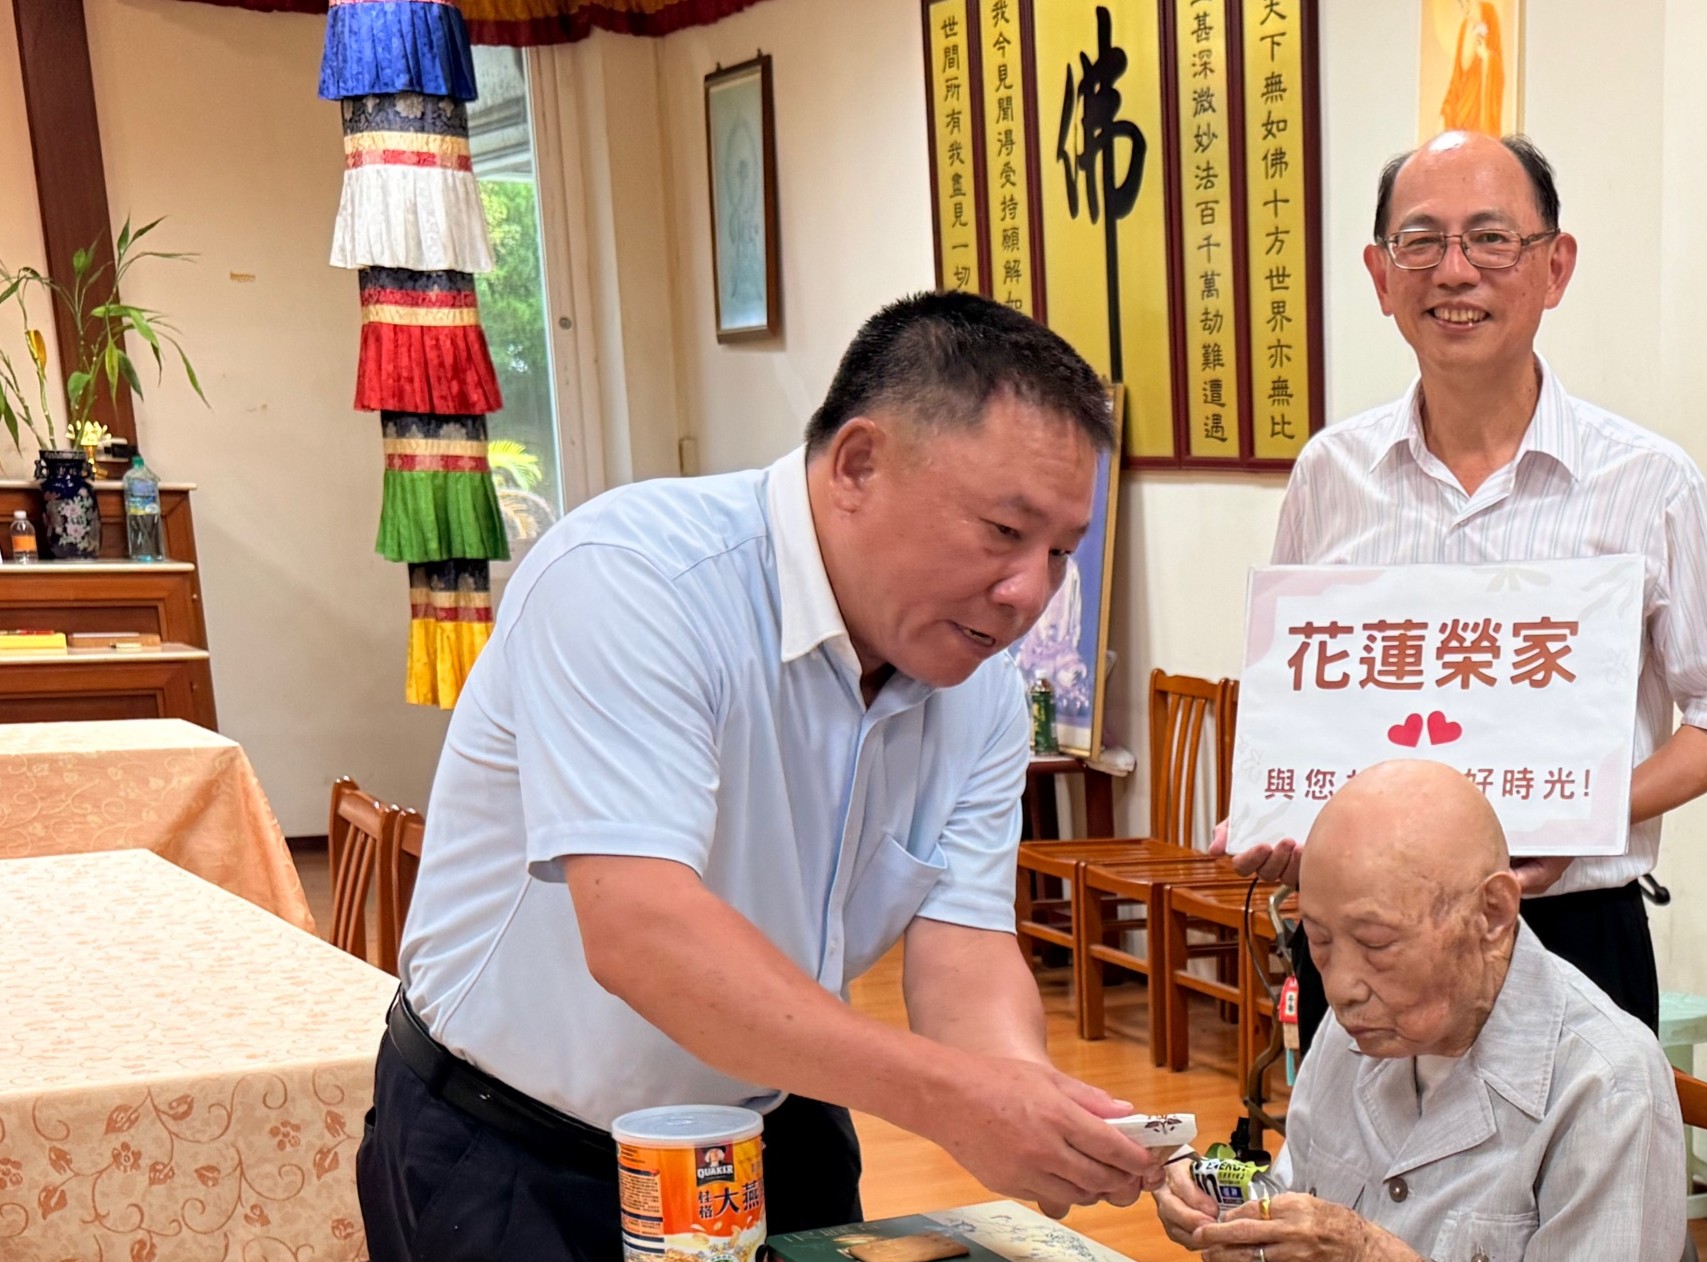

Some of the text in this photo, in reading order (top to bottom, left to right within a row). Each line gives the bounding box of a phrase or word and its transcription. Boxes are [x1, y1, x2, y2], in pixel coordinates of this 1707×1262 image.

[1056, 5, 1147, 384] 佛
[1190, 0, 1228, 443] 甚深微妙法百千萬劫難遭遇
[1287, 616, 1579, 691] 花蓮榮家
[1264, 767, 1592, 801] 與您好時光!
[697, 1165, 734, 1179] QUAKER
